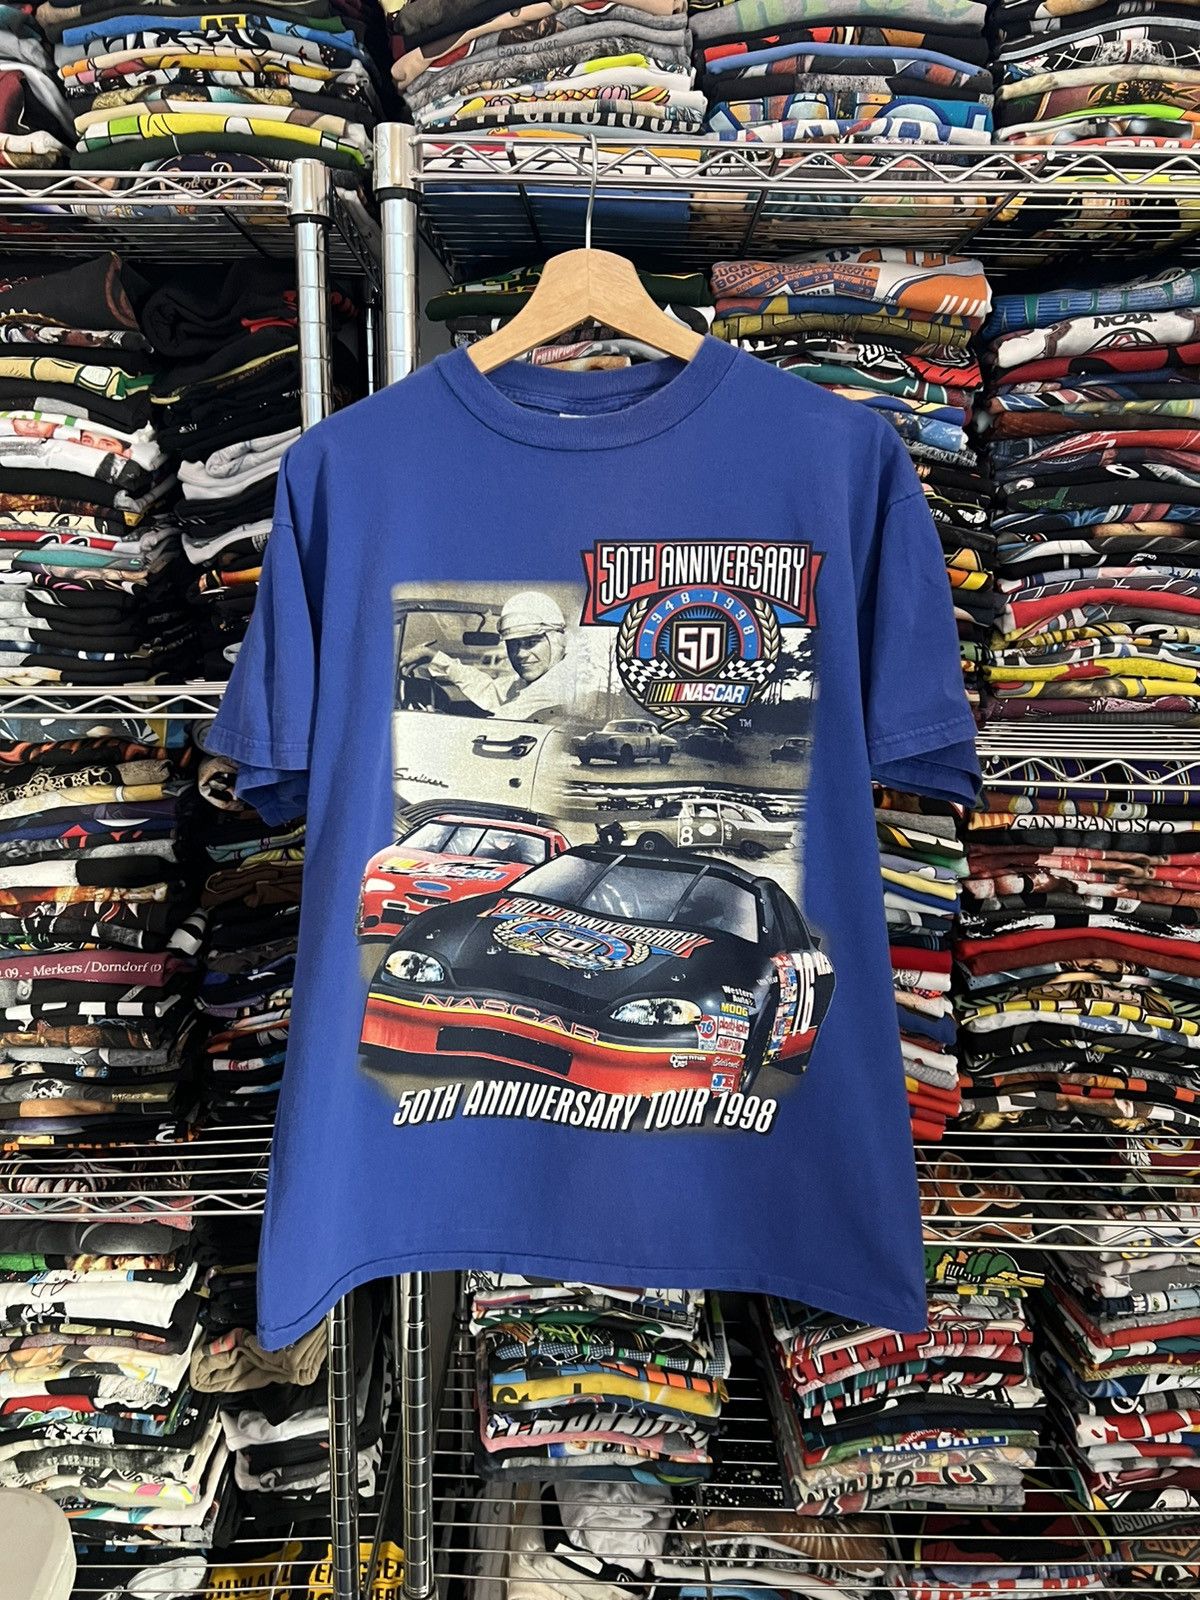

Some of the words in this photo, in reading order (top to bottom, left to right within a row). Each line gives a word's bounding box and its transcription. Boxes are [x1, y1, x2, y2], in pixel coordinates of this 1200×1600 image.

[601, 545, 654, 605] 50TH
[660, 545, 806, 608] ANNIVERSARY
[677, 627, 721, 673] 50
[680, 683, 746, 704] NASCAR
[739, 718, 752, 728] TM
[420, 993, 600, 1044] NASCAR
[720, 1002, 748, 1016] MOOG
[701, 1021, 713, 1033] 76
[393, 1082, 461, 1126] 50TH
[463, 1080, 641, 1131] ANNIVERSARY
[646, 1088, 707, 1128] TOUR
[713, 1090, 777, 1133] 1998
